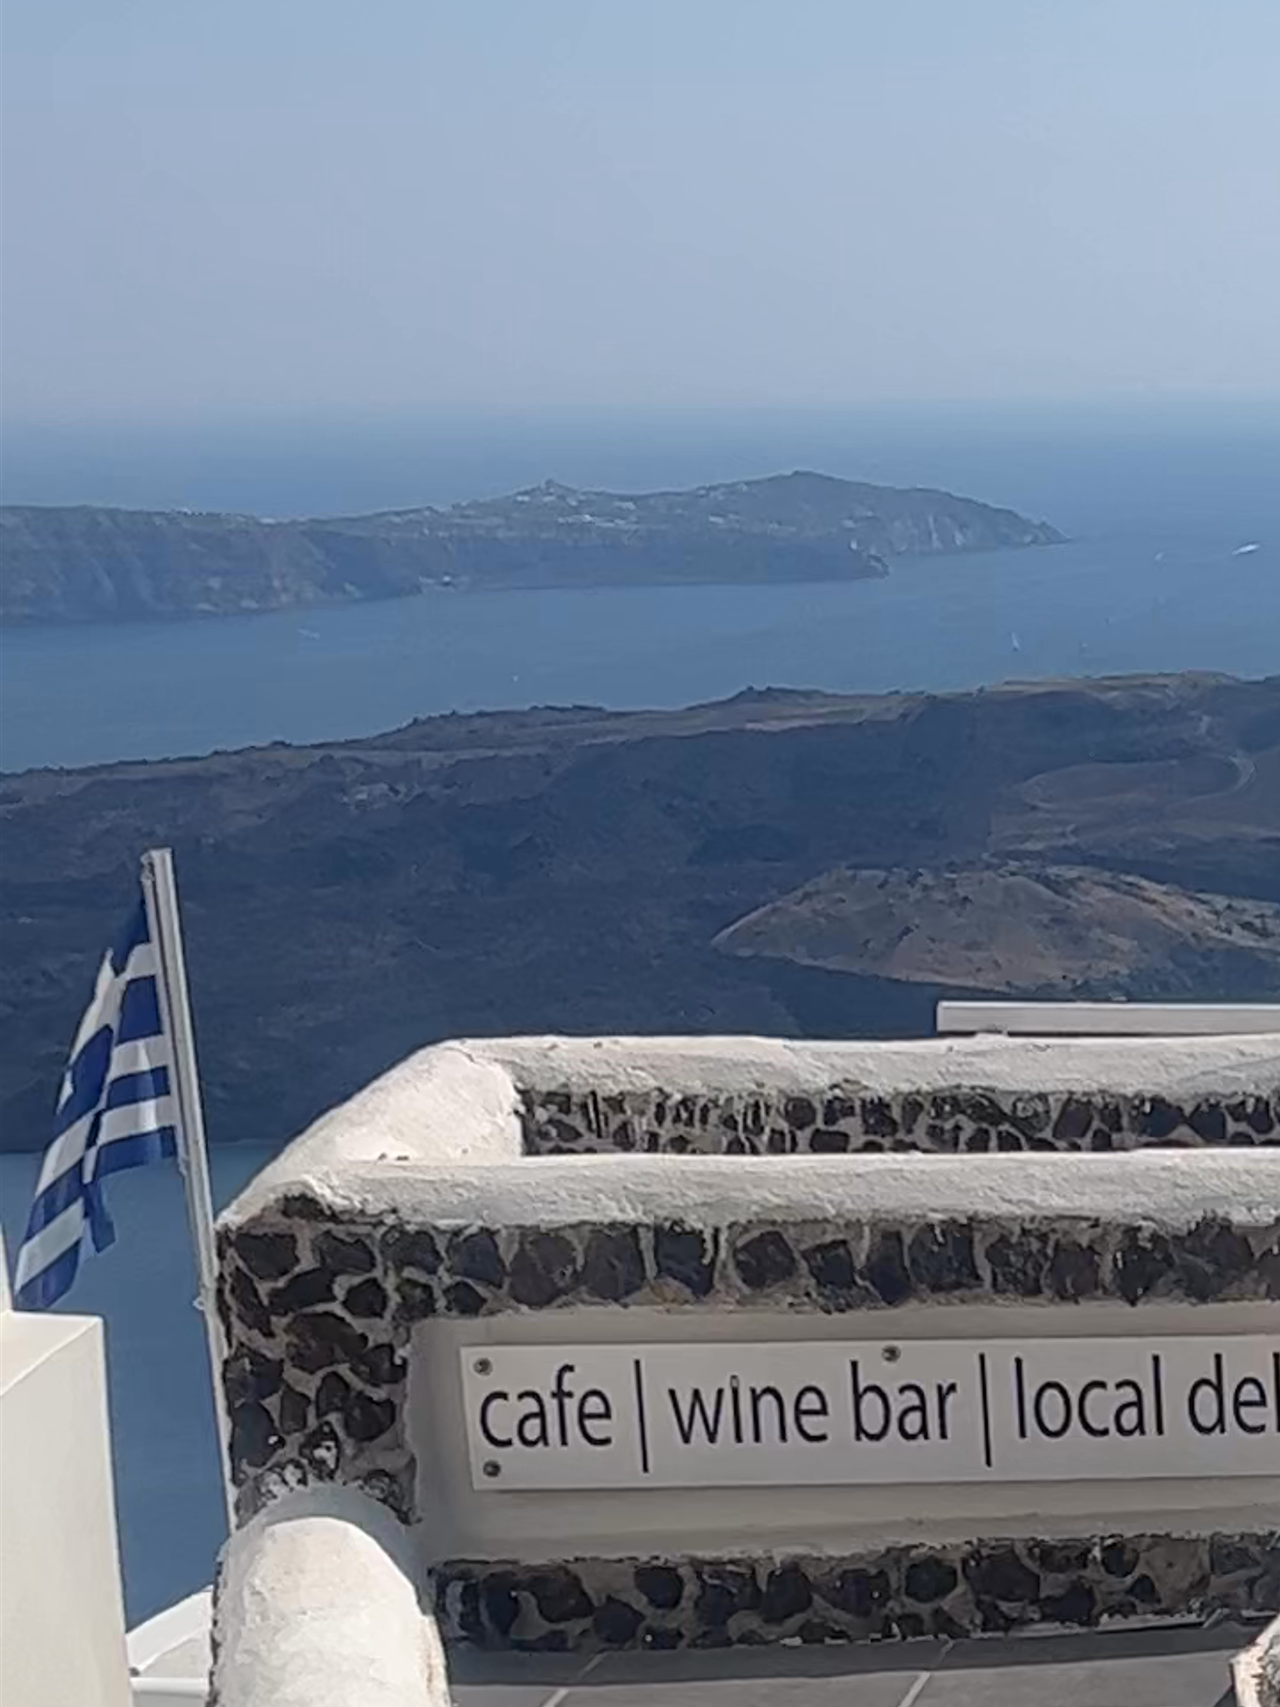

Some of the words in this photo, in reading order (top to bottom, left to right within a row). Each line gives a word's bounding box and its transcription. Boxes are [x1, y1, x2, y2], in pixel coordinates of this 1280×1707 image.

[478, 1364, 612, 1448] cafe
[668, 1374, 829, 1444] wine
[850, 1359, 958, 1442] bar
[1014, 1354, 1165, 1439] local
